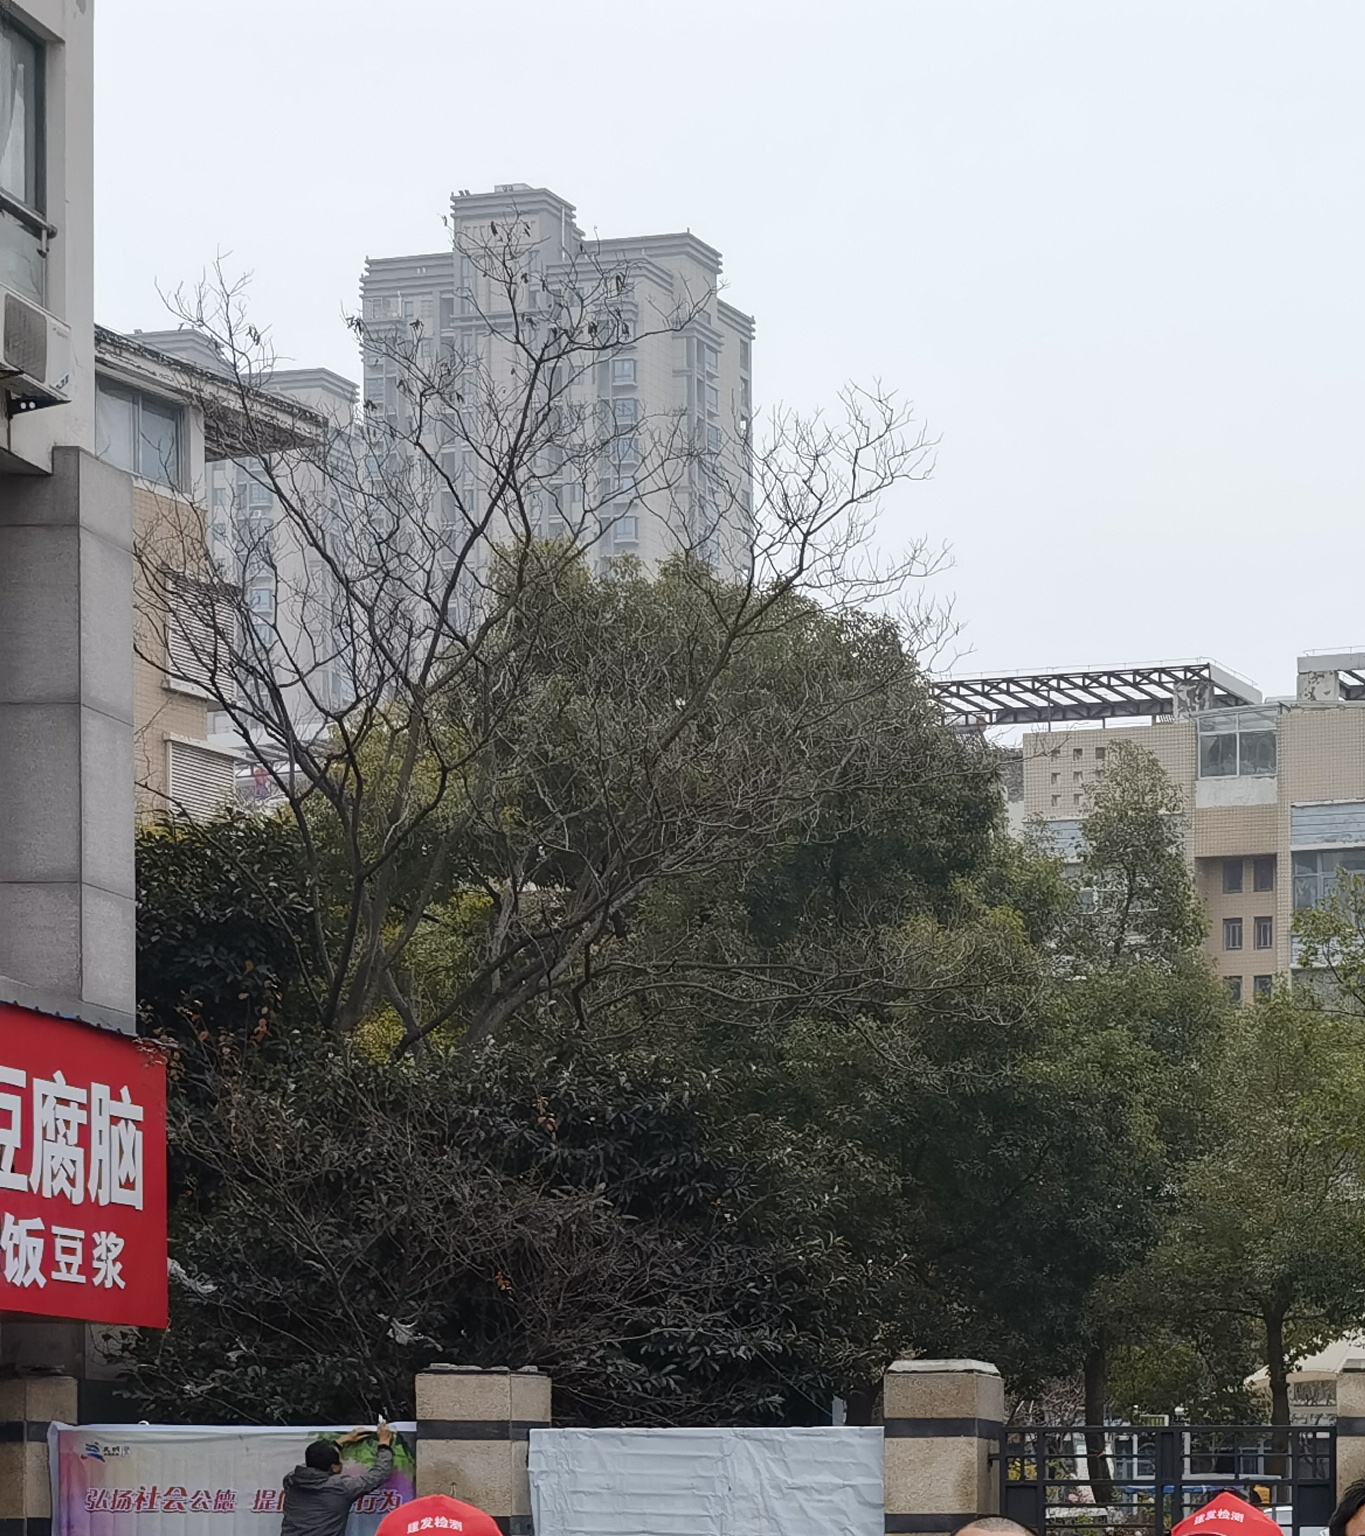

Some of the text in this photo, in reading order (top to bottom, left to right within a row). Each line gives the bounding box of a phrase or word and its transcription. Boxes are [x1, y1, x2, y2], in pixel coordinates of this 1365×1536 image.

[86, 1486, 236, 1513] 弘扬社会公德
[407, 1516, 462, 1534] 建发检测
[1193, 1509, 1244, 1525] 建发检测
